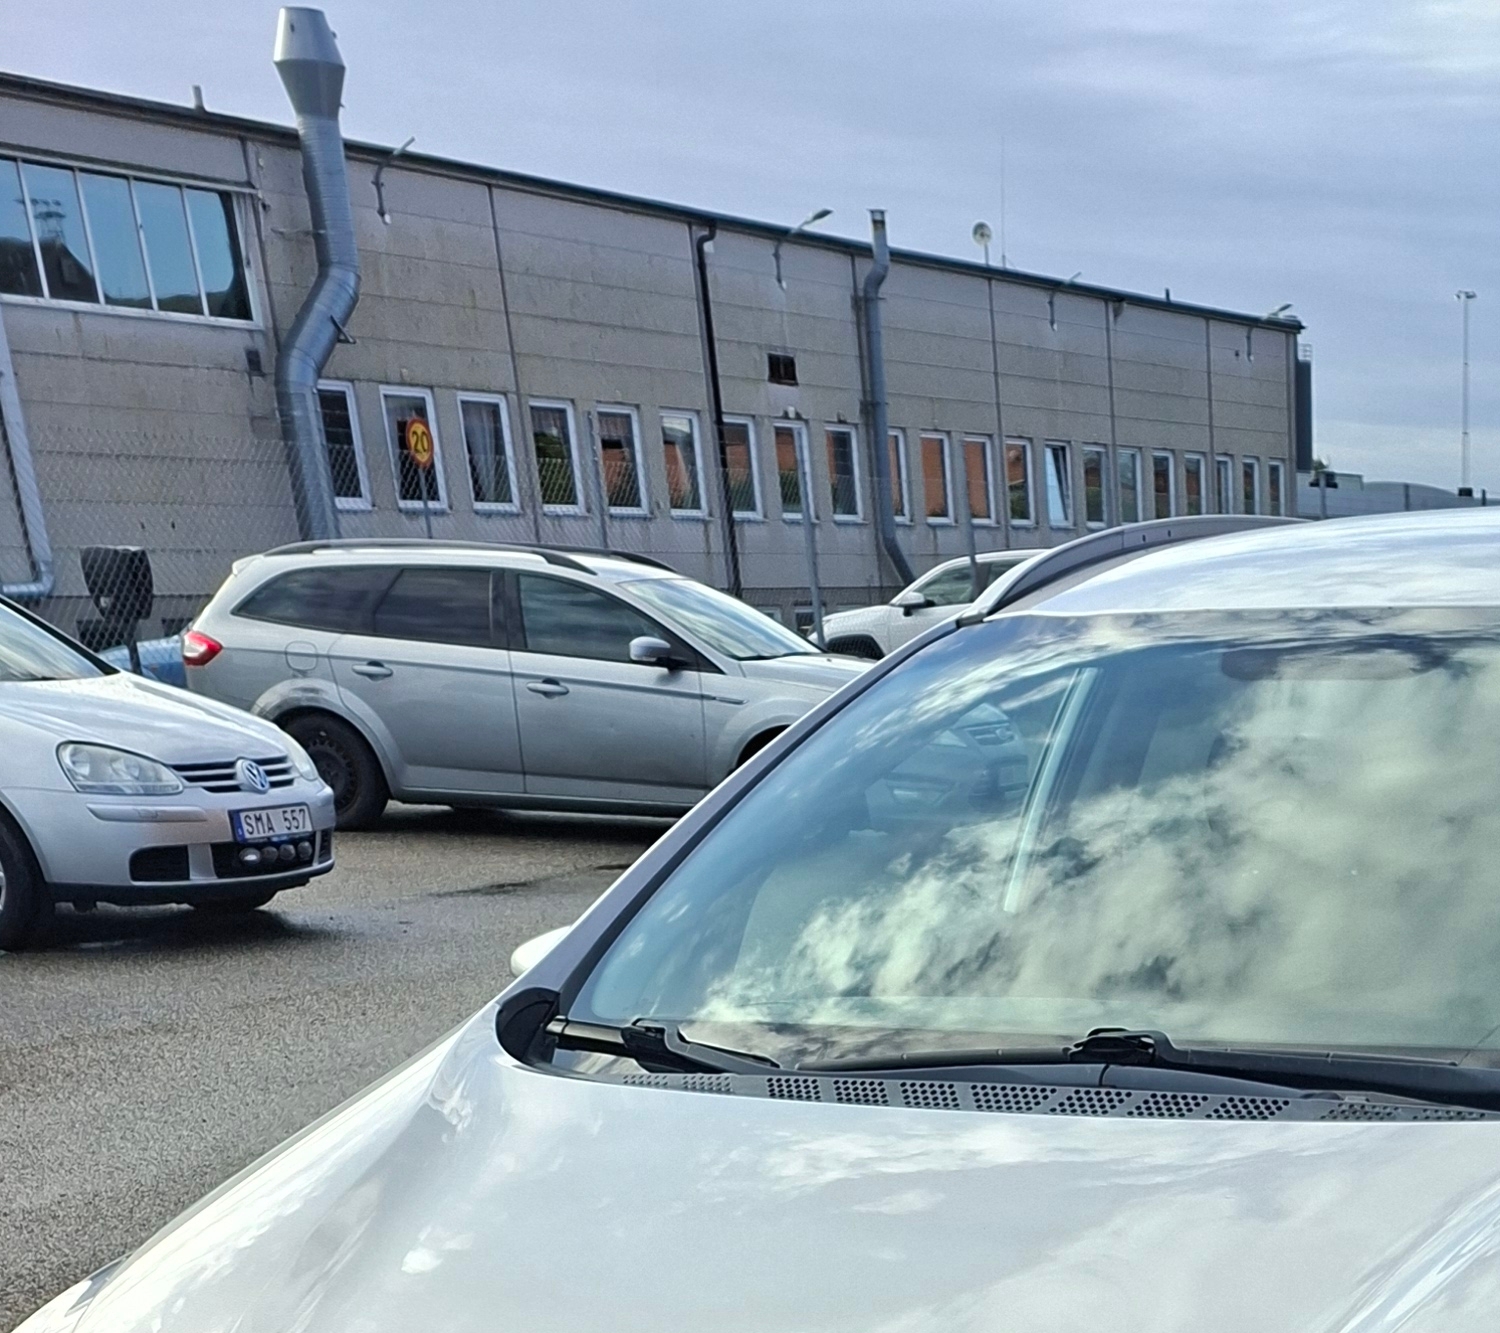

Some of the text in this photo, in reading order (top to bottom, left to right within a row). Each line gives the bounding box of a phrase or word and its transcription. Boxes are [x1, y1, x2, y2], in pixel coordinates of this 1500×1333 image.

[411, 430, 429, 454] 20
[244, 808, 306, 835] SMA 557
